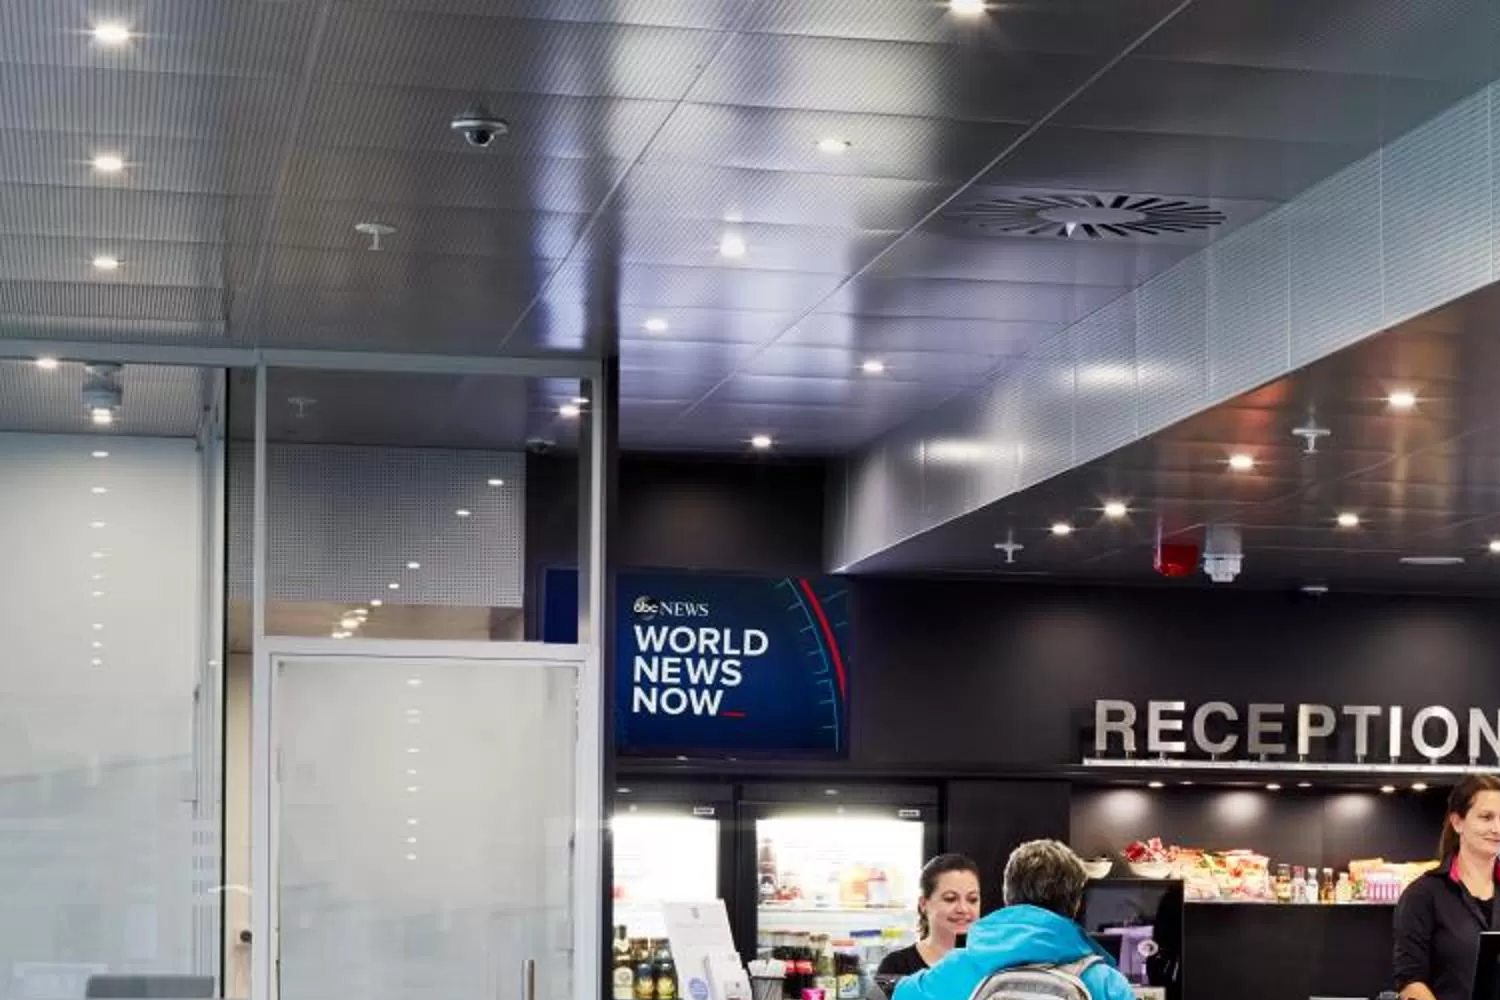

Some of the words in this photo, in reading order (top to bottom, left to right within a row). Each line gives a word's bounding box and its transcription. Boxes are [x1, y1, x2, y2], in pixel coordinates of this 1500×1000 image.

[660, 601, 709, 617] NEWS
[633, 624, 769, 656] WORLD
[633, 655, 743, 687] NEWS
[632, 686, 724, 716] NOW
